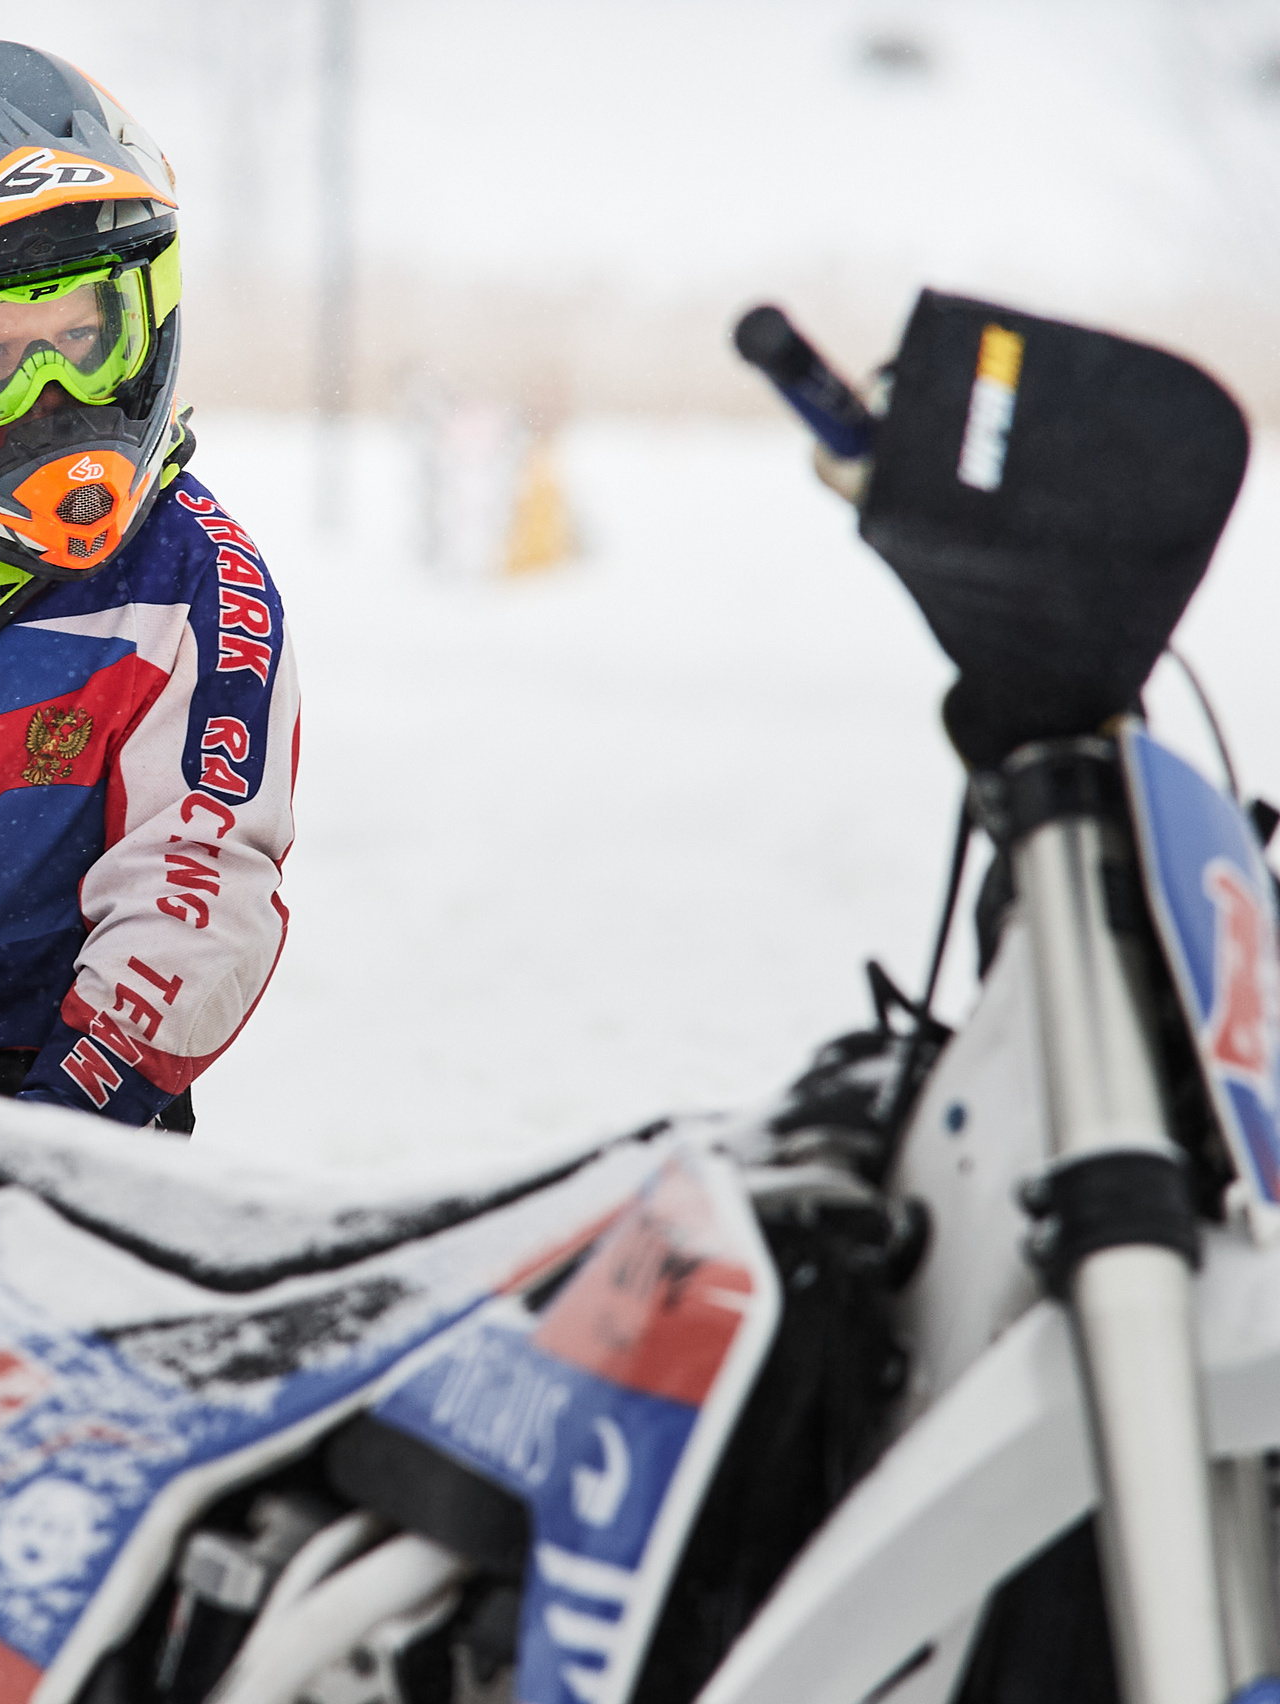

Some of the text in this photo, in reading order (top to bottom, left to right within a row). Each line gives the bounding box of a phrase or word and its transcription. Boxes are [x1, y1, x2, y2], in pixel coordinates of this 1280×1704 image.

[67, 455, 104, 482] 6D
[60, 490, 273, 1109] SHARK RACING TEAM
